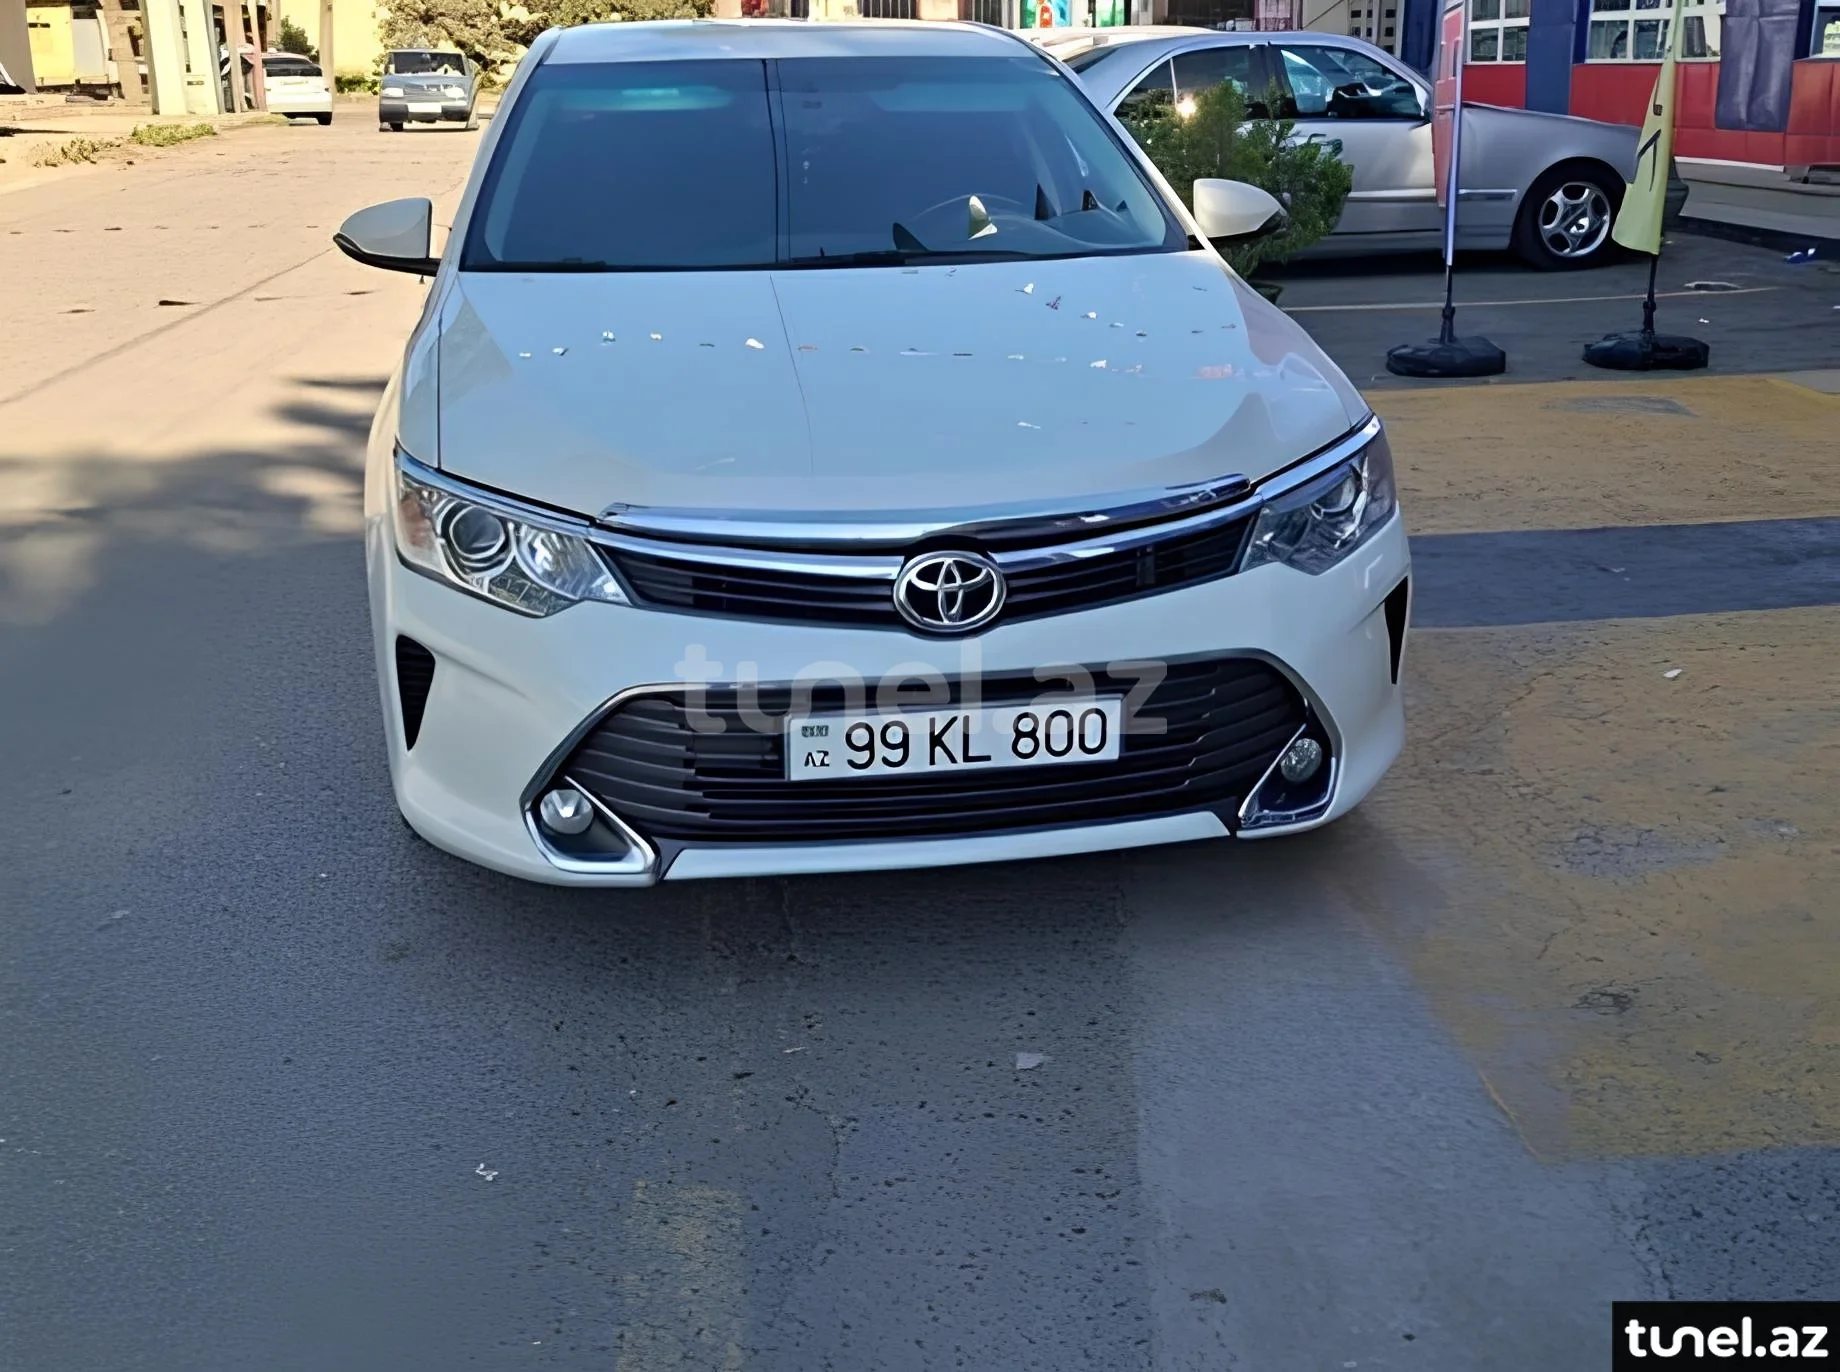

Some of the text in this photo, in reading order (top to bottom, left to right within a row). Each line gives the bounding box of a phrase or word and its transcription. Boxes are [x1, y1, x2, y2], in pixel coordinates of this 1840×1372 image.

[845, 708, 1107, 770] 99 KL 800
